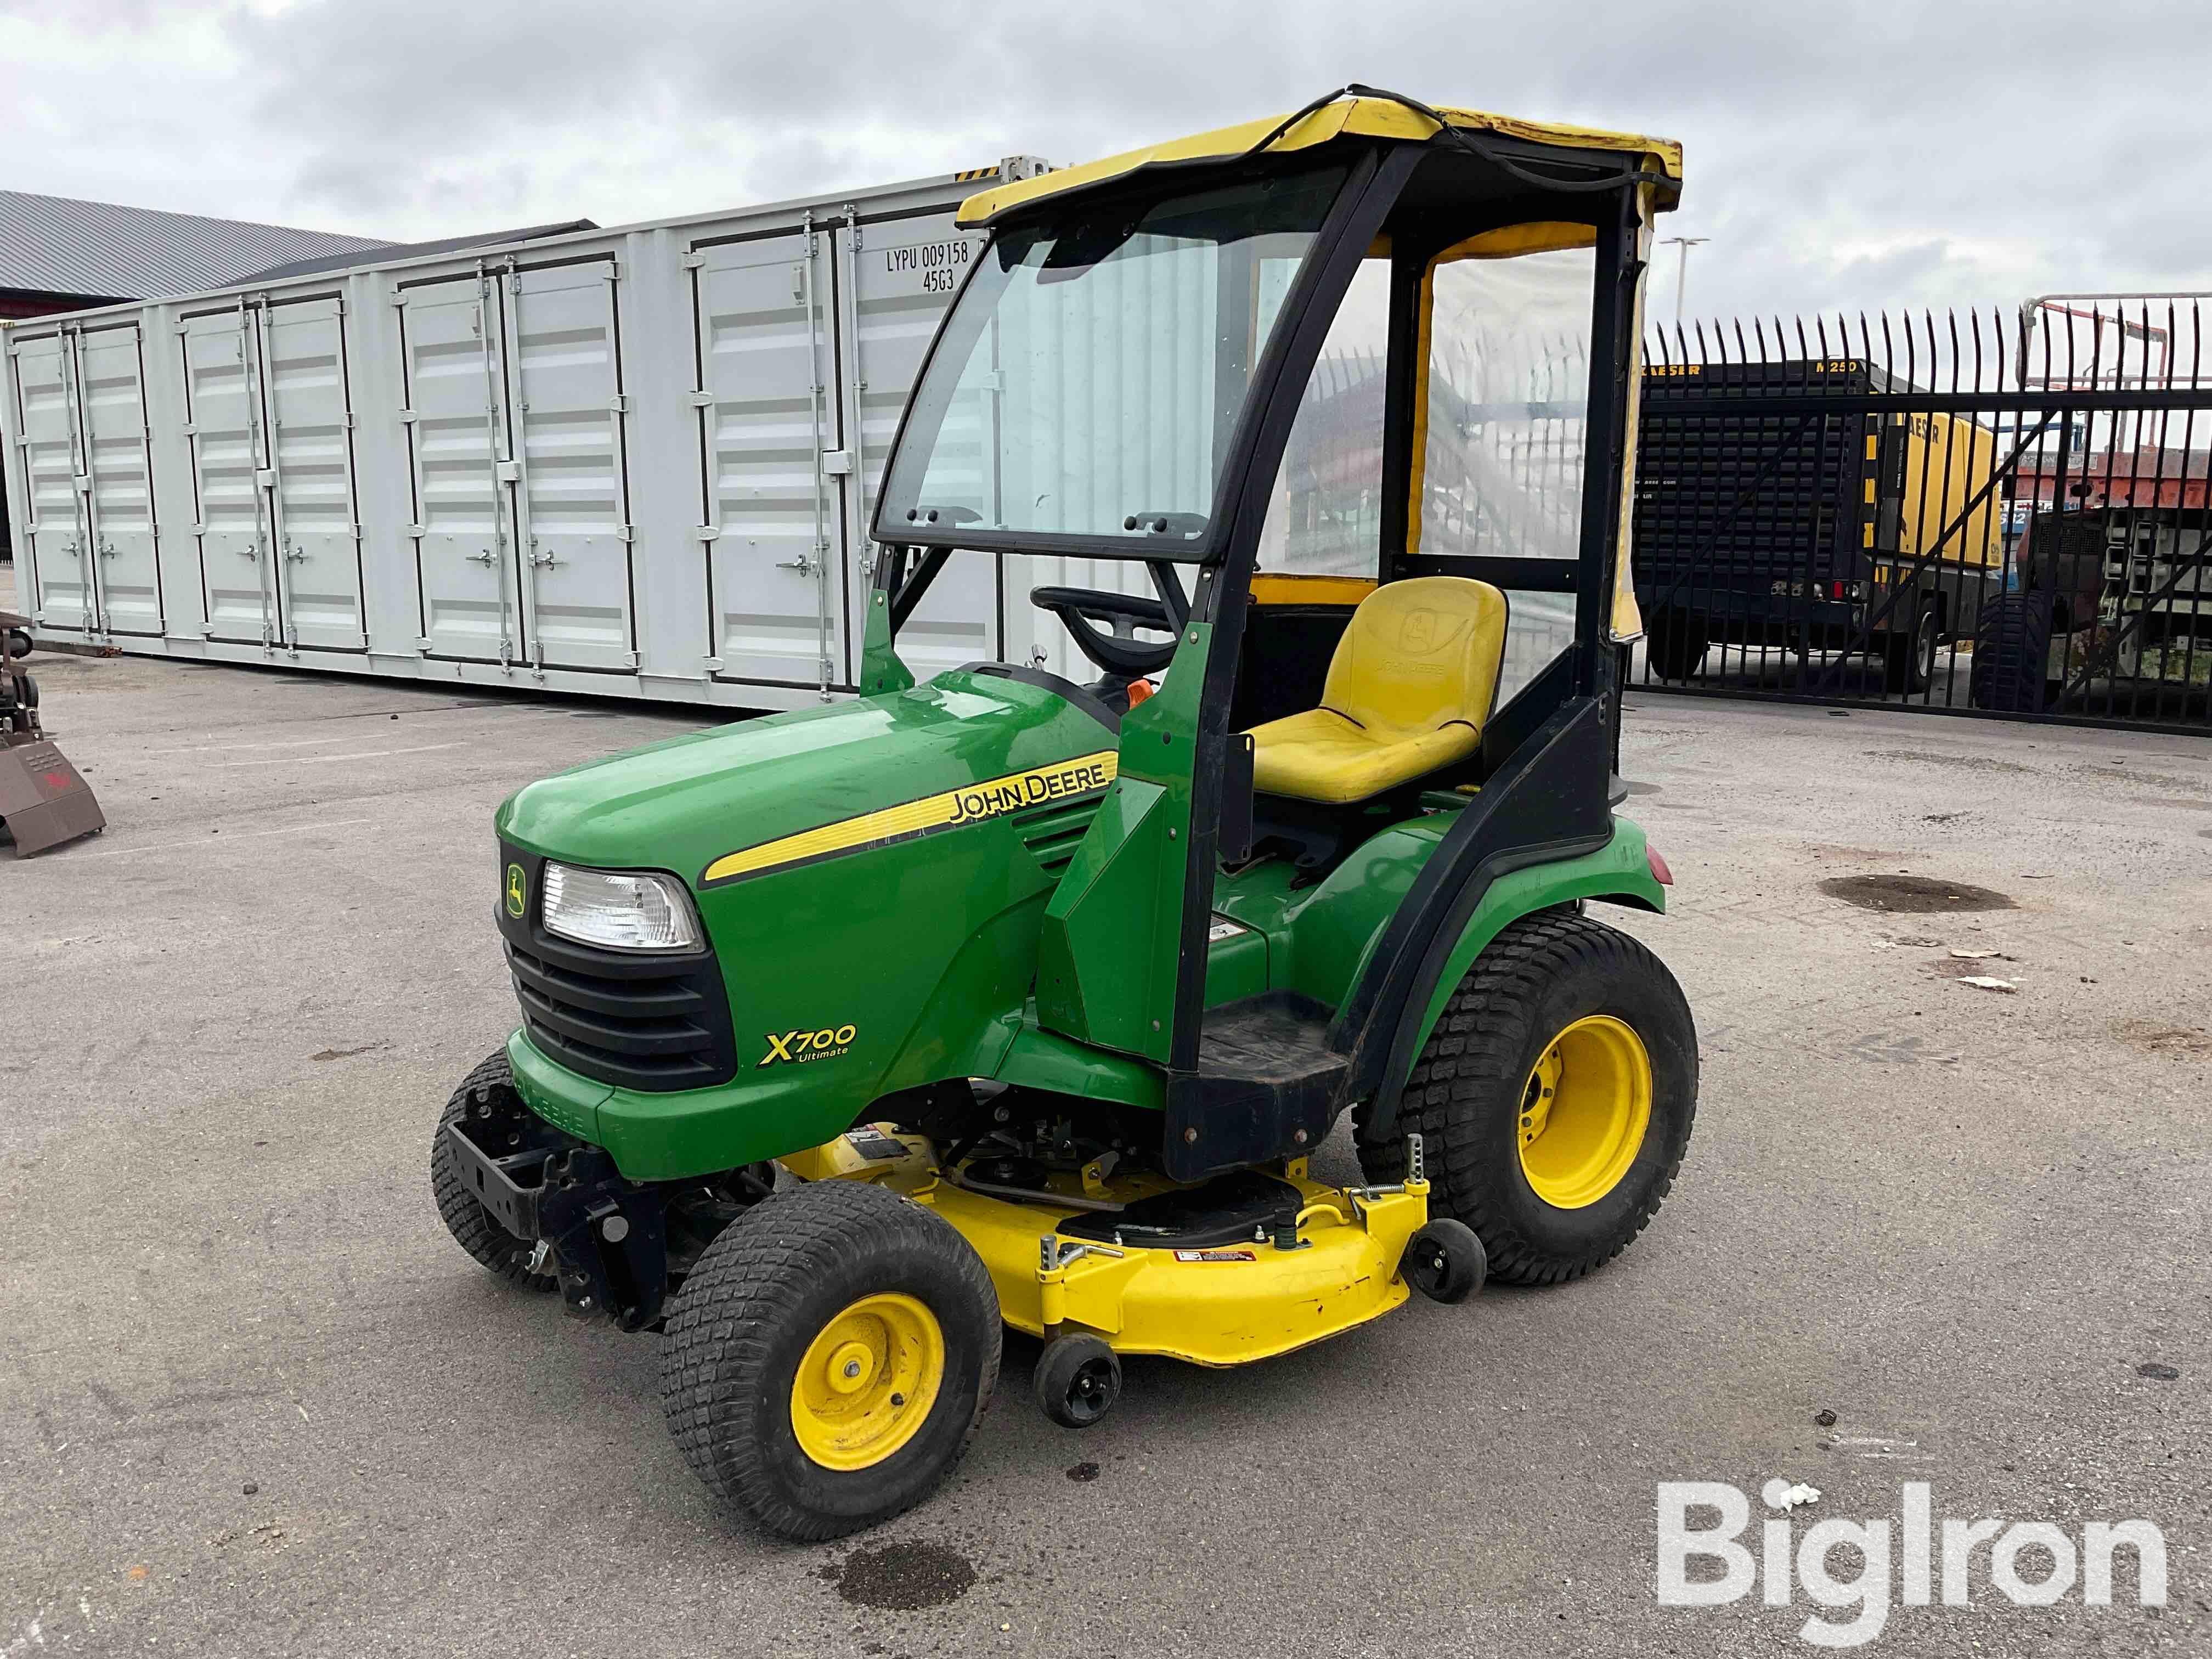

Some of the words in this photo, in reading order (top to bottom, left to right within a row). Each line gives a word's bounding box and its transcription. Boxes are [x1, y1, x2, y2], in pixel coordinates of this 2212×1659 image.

[887, 247, 917, 272] LYPU
[922, 241, 968, 267] 009158
[923, 268, 953, 292] 45G3
[950, 784, 1023, 821] JOHN
[1024, 763, 1107, 801] DEERE
[759, 1024, 856, 1065] X700
[799, 1046, 848, 1063] Ultimate
